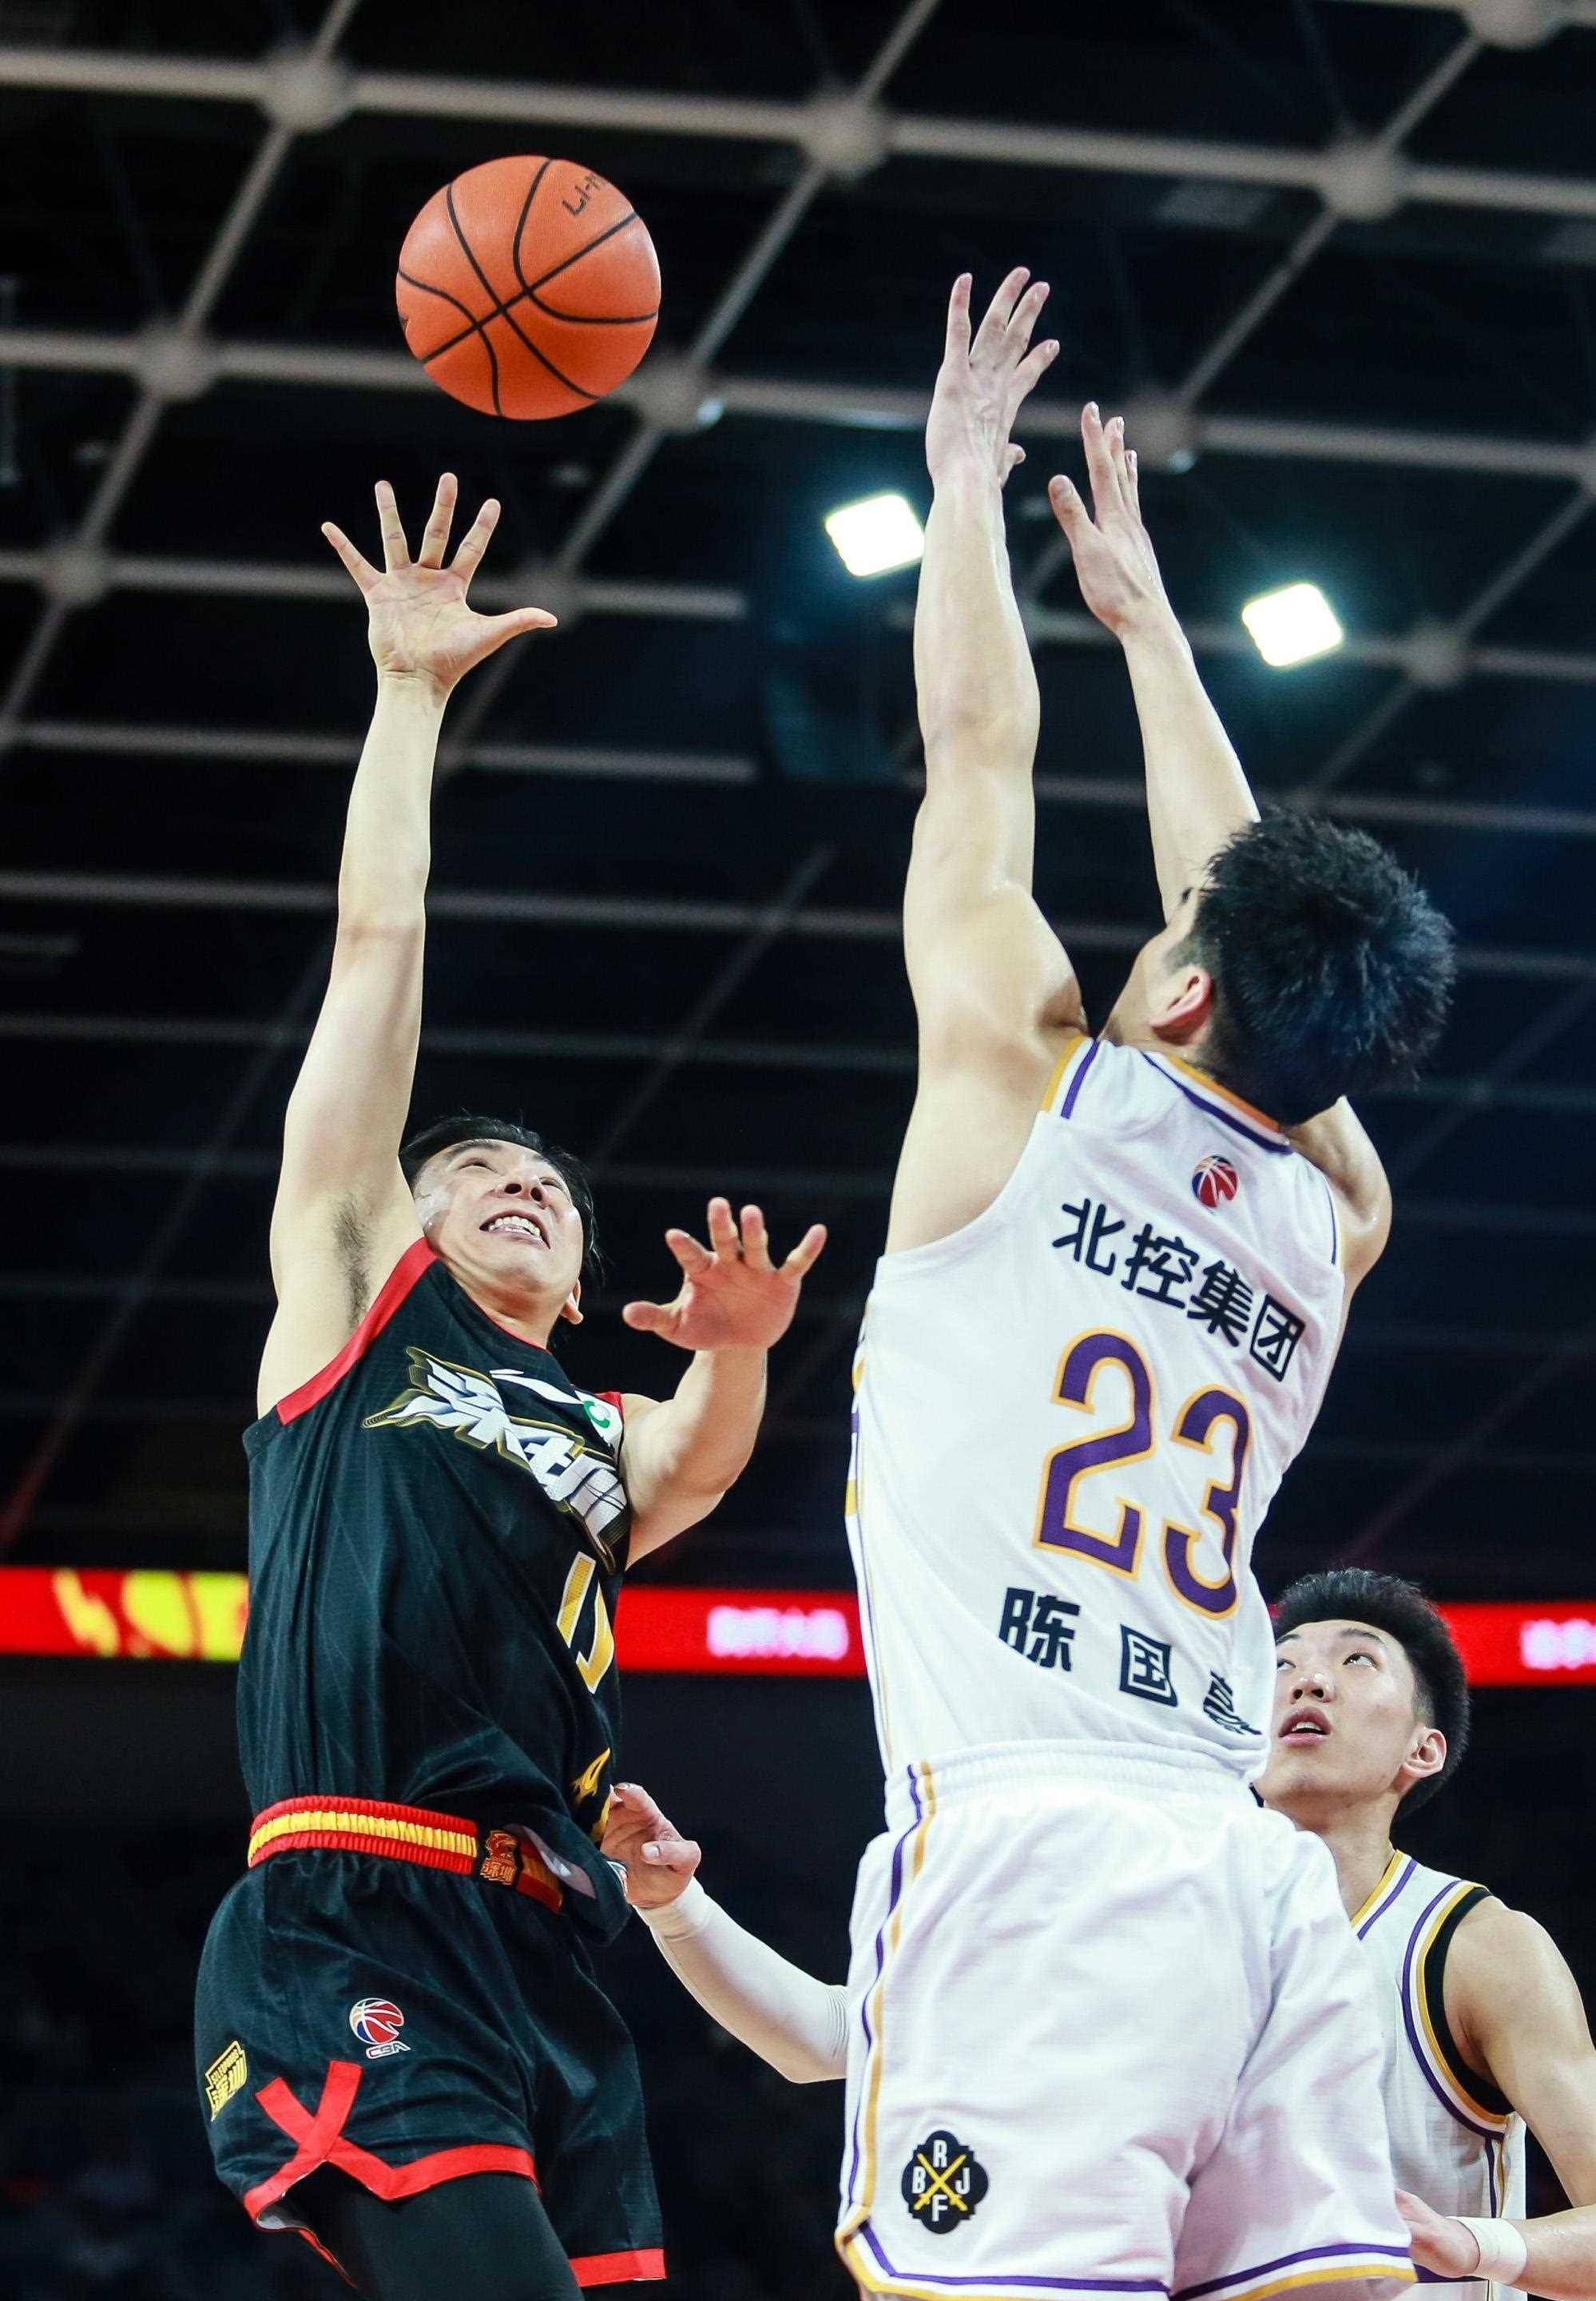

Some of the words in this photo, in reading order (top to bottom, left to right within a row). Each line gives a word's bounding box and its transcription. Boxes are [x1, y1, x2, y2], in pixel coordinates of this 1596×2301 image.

[1052, 1198, 1306, 1382] 北控集团
[1033, 1325, 1250, 1621] 23
[933, 2139, 948, 2168] R
